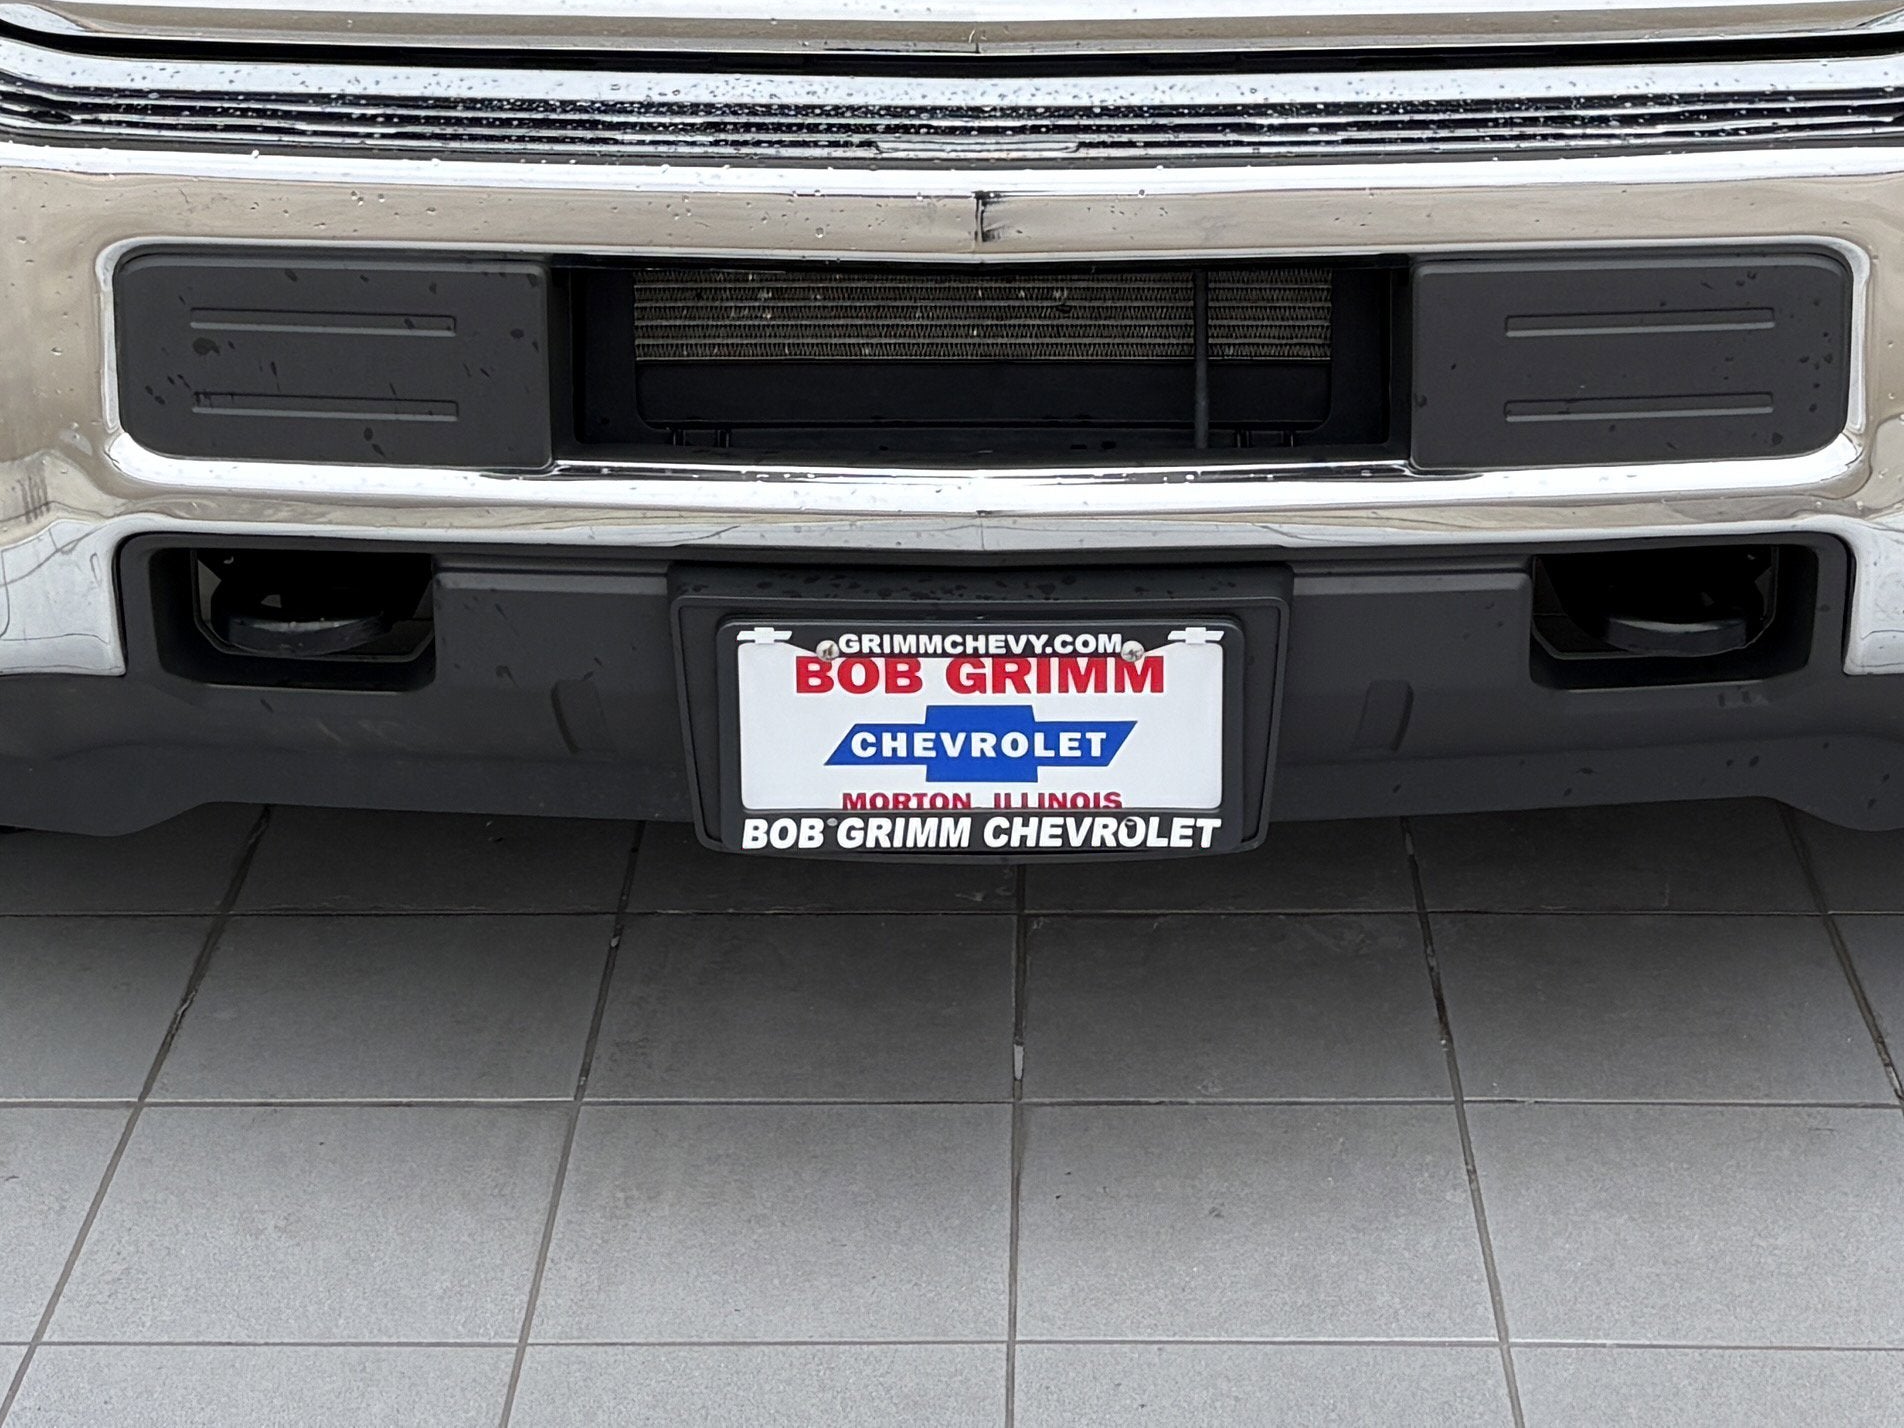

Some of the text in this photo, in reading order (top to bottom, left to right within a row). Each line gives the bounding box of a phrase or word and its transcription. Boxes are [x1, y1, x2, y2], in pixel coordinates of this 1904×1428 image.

[838, 633, 1122, 655] GRIMMCHEVY.COM
[796, 656, 1165, 694] BOB GRIMM
[850, 731, 1108, 759] CHEVROLET
[841, 792, 972, 810] MORTON
[741, 816, 1222, 850] BOB GRIMM CHEVROLET
